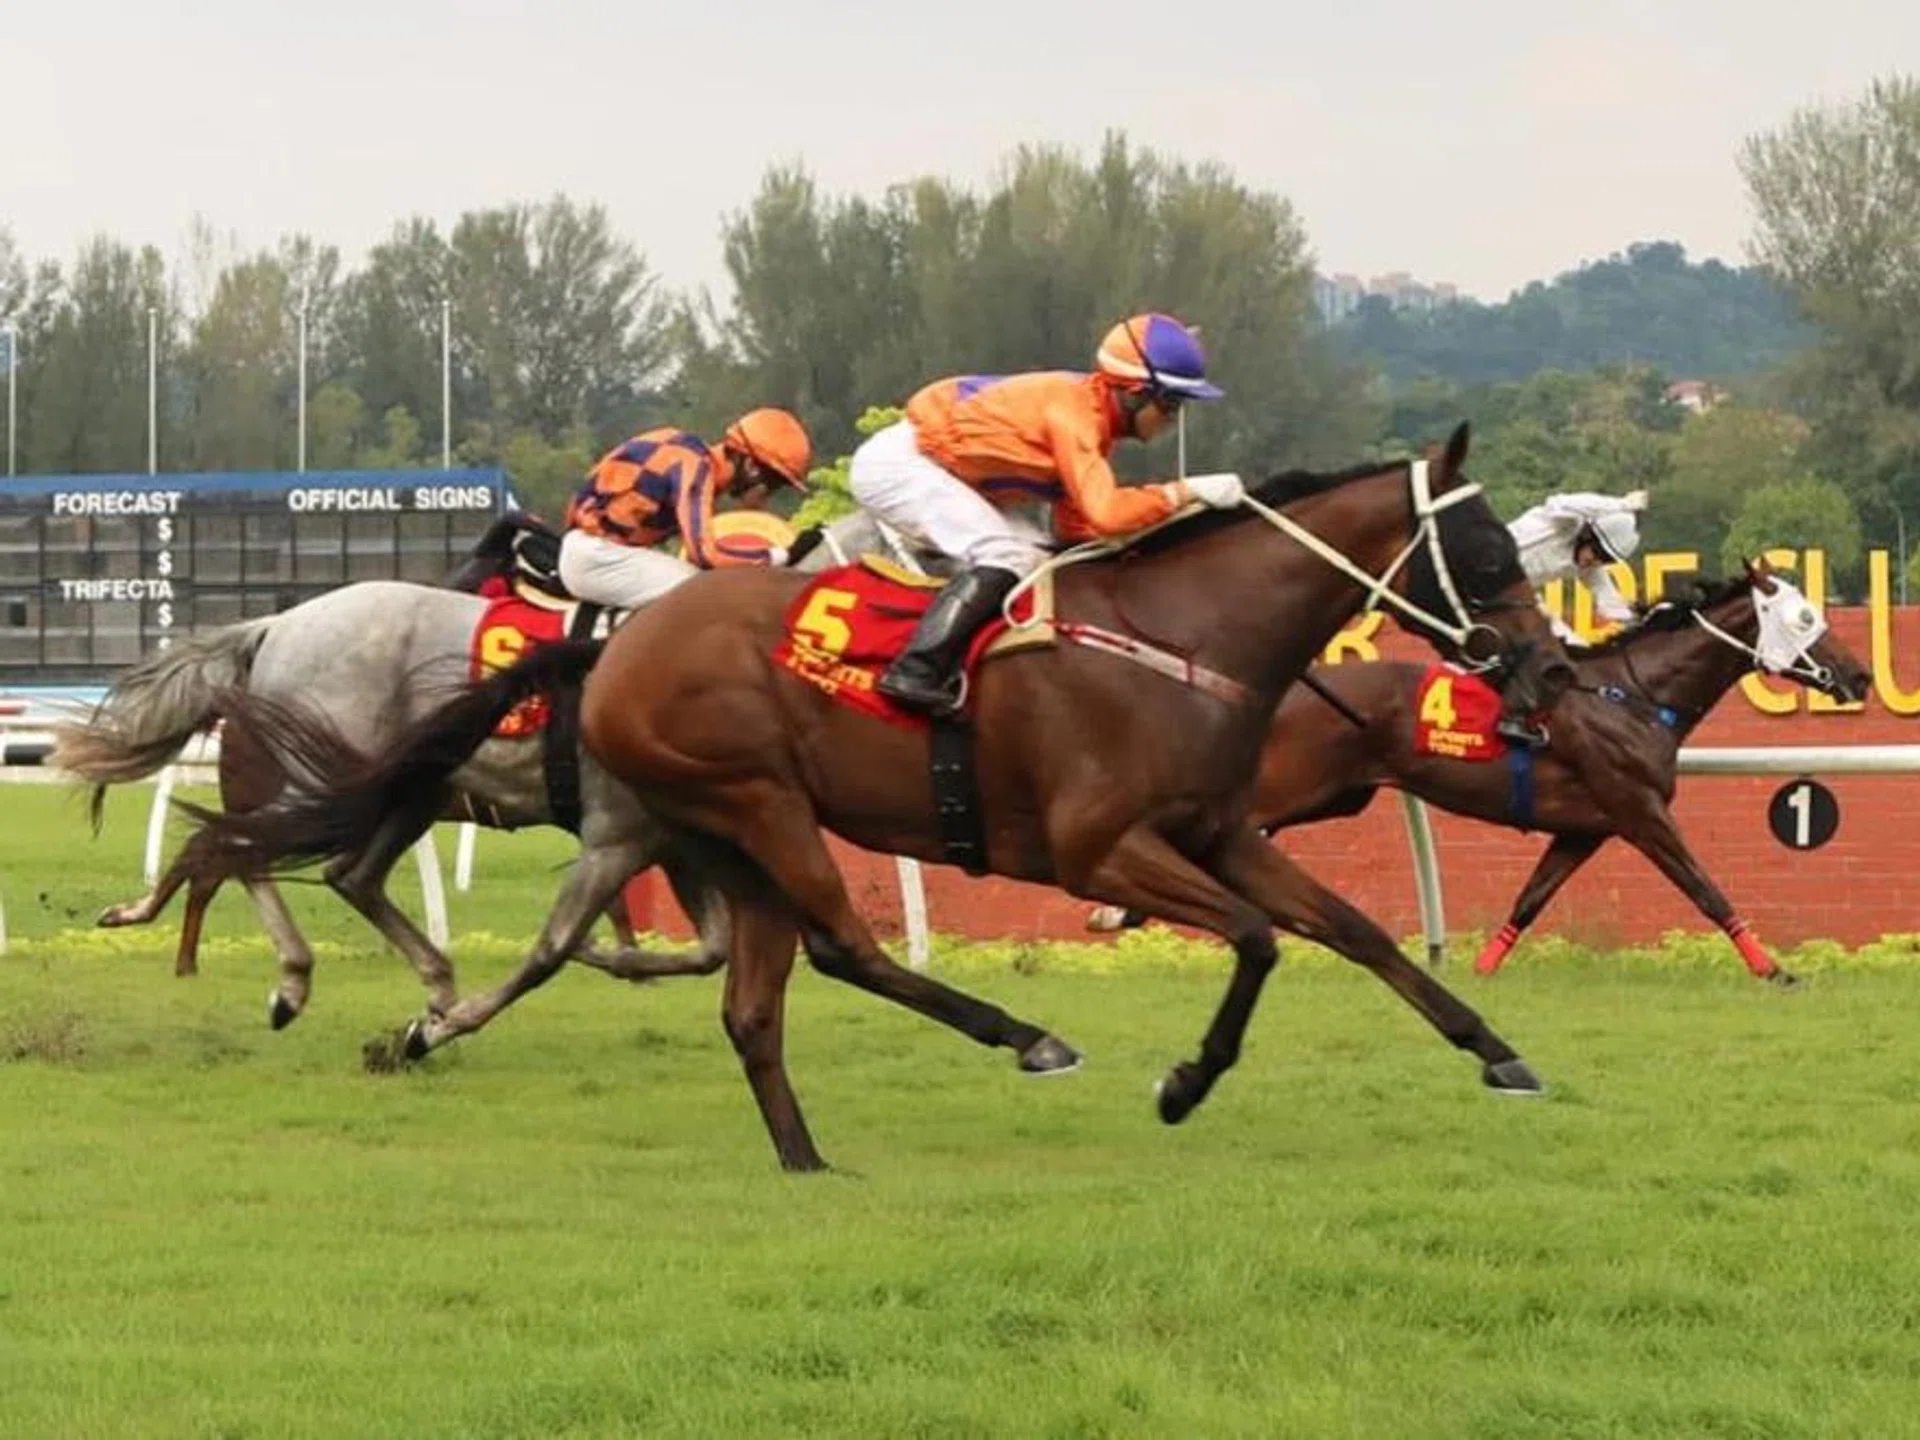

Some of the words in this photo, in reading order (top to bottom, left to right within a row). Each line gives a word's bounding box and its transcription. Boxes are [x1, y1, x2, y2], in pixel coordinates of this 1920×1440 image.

[53, 491, 181, 514] FORECAST
[288, 488, 401, 511] OFFICIAL
[414, 486, 492, 510] SIGNS
[59, 579, 174, 600] TRIFECTA
[795, 587, 858, 654] 5
[1420, 676, 1457, 729] 4
[1788, 785, 1811, 846] 1
